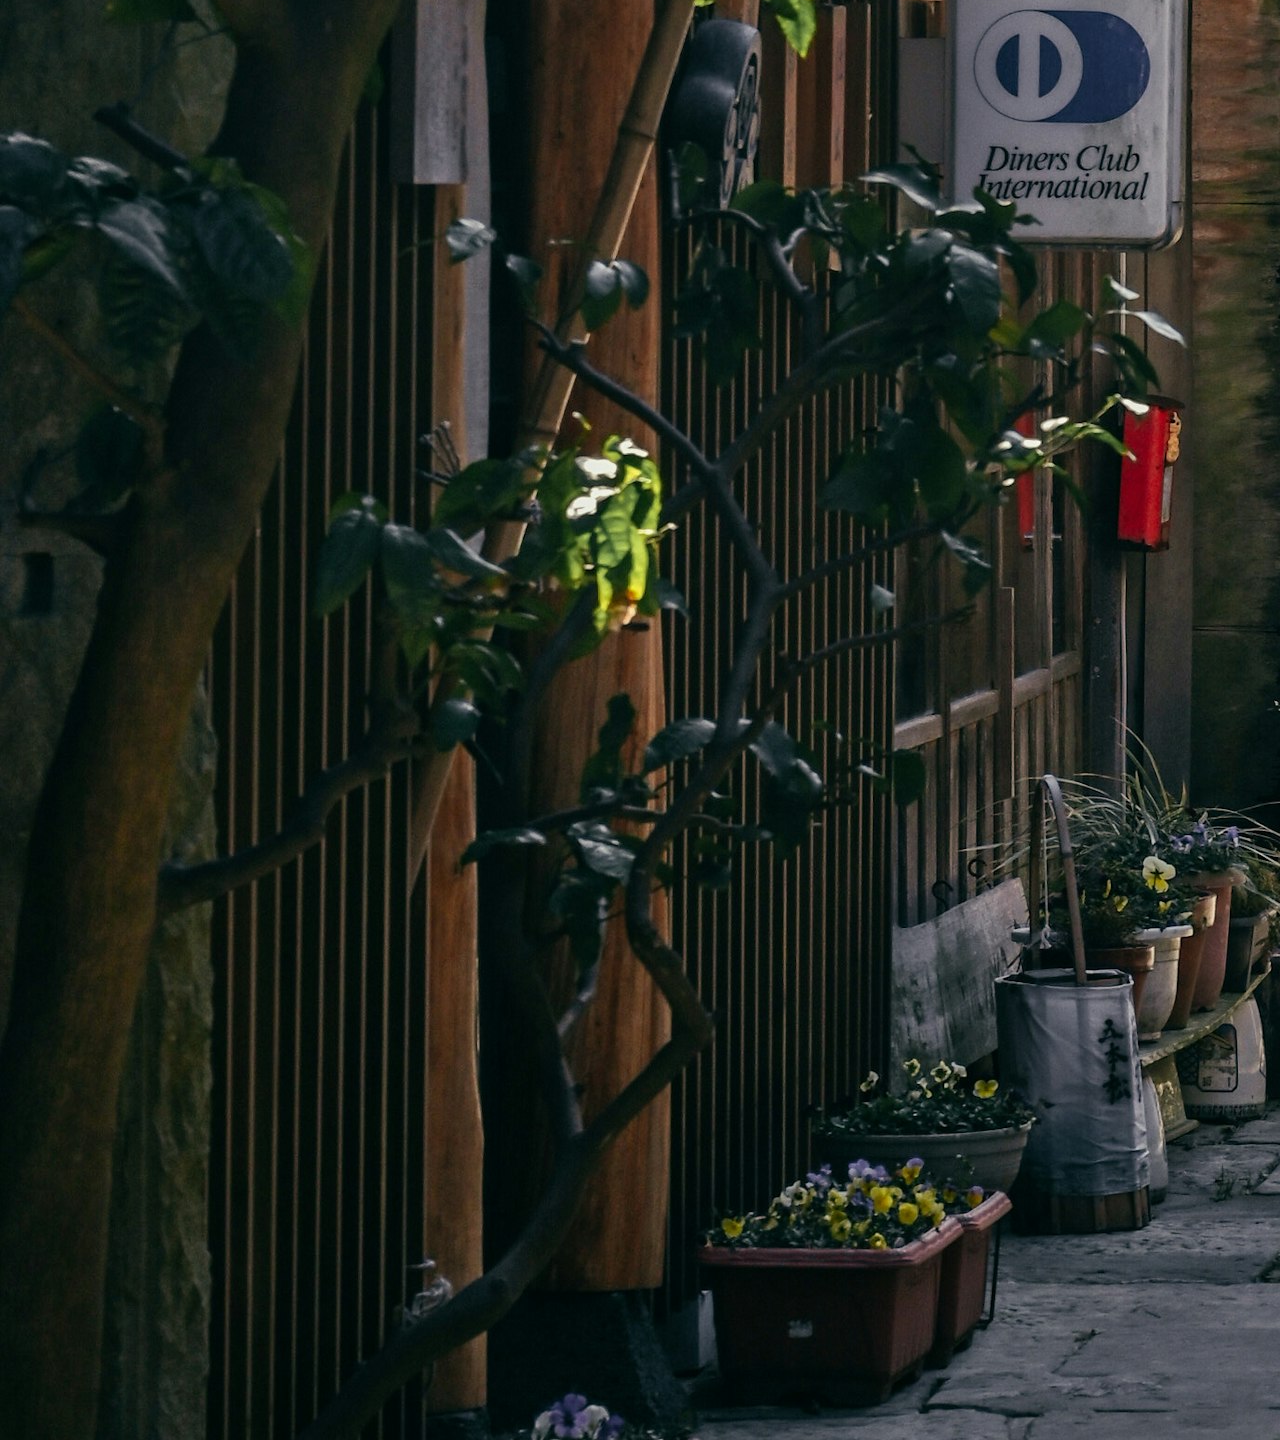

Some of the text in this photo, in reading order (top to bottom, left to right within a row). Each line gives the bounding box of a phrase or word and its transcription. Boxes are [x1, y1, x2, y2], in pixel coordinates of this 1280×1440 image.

[984, 143, 1141, 172] Diners Club
[978, 172, 1150, 201] International
